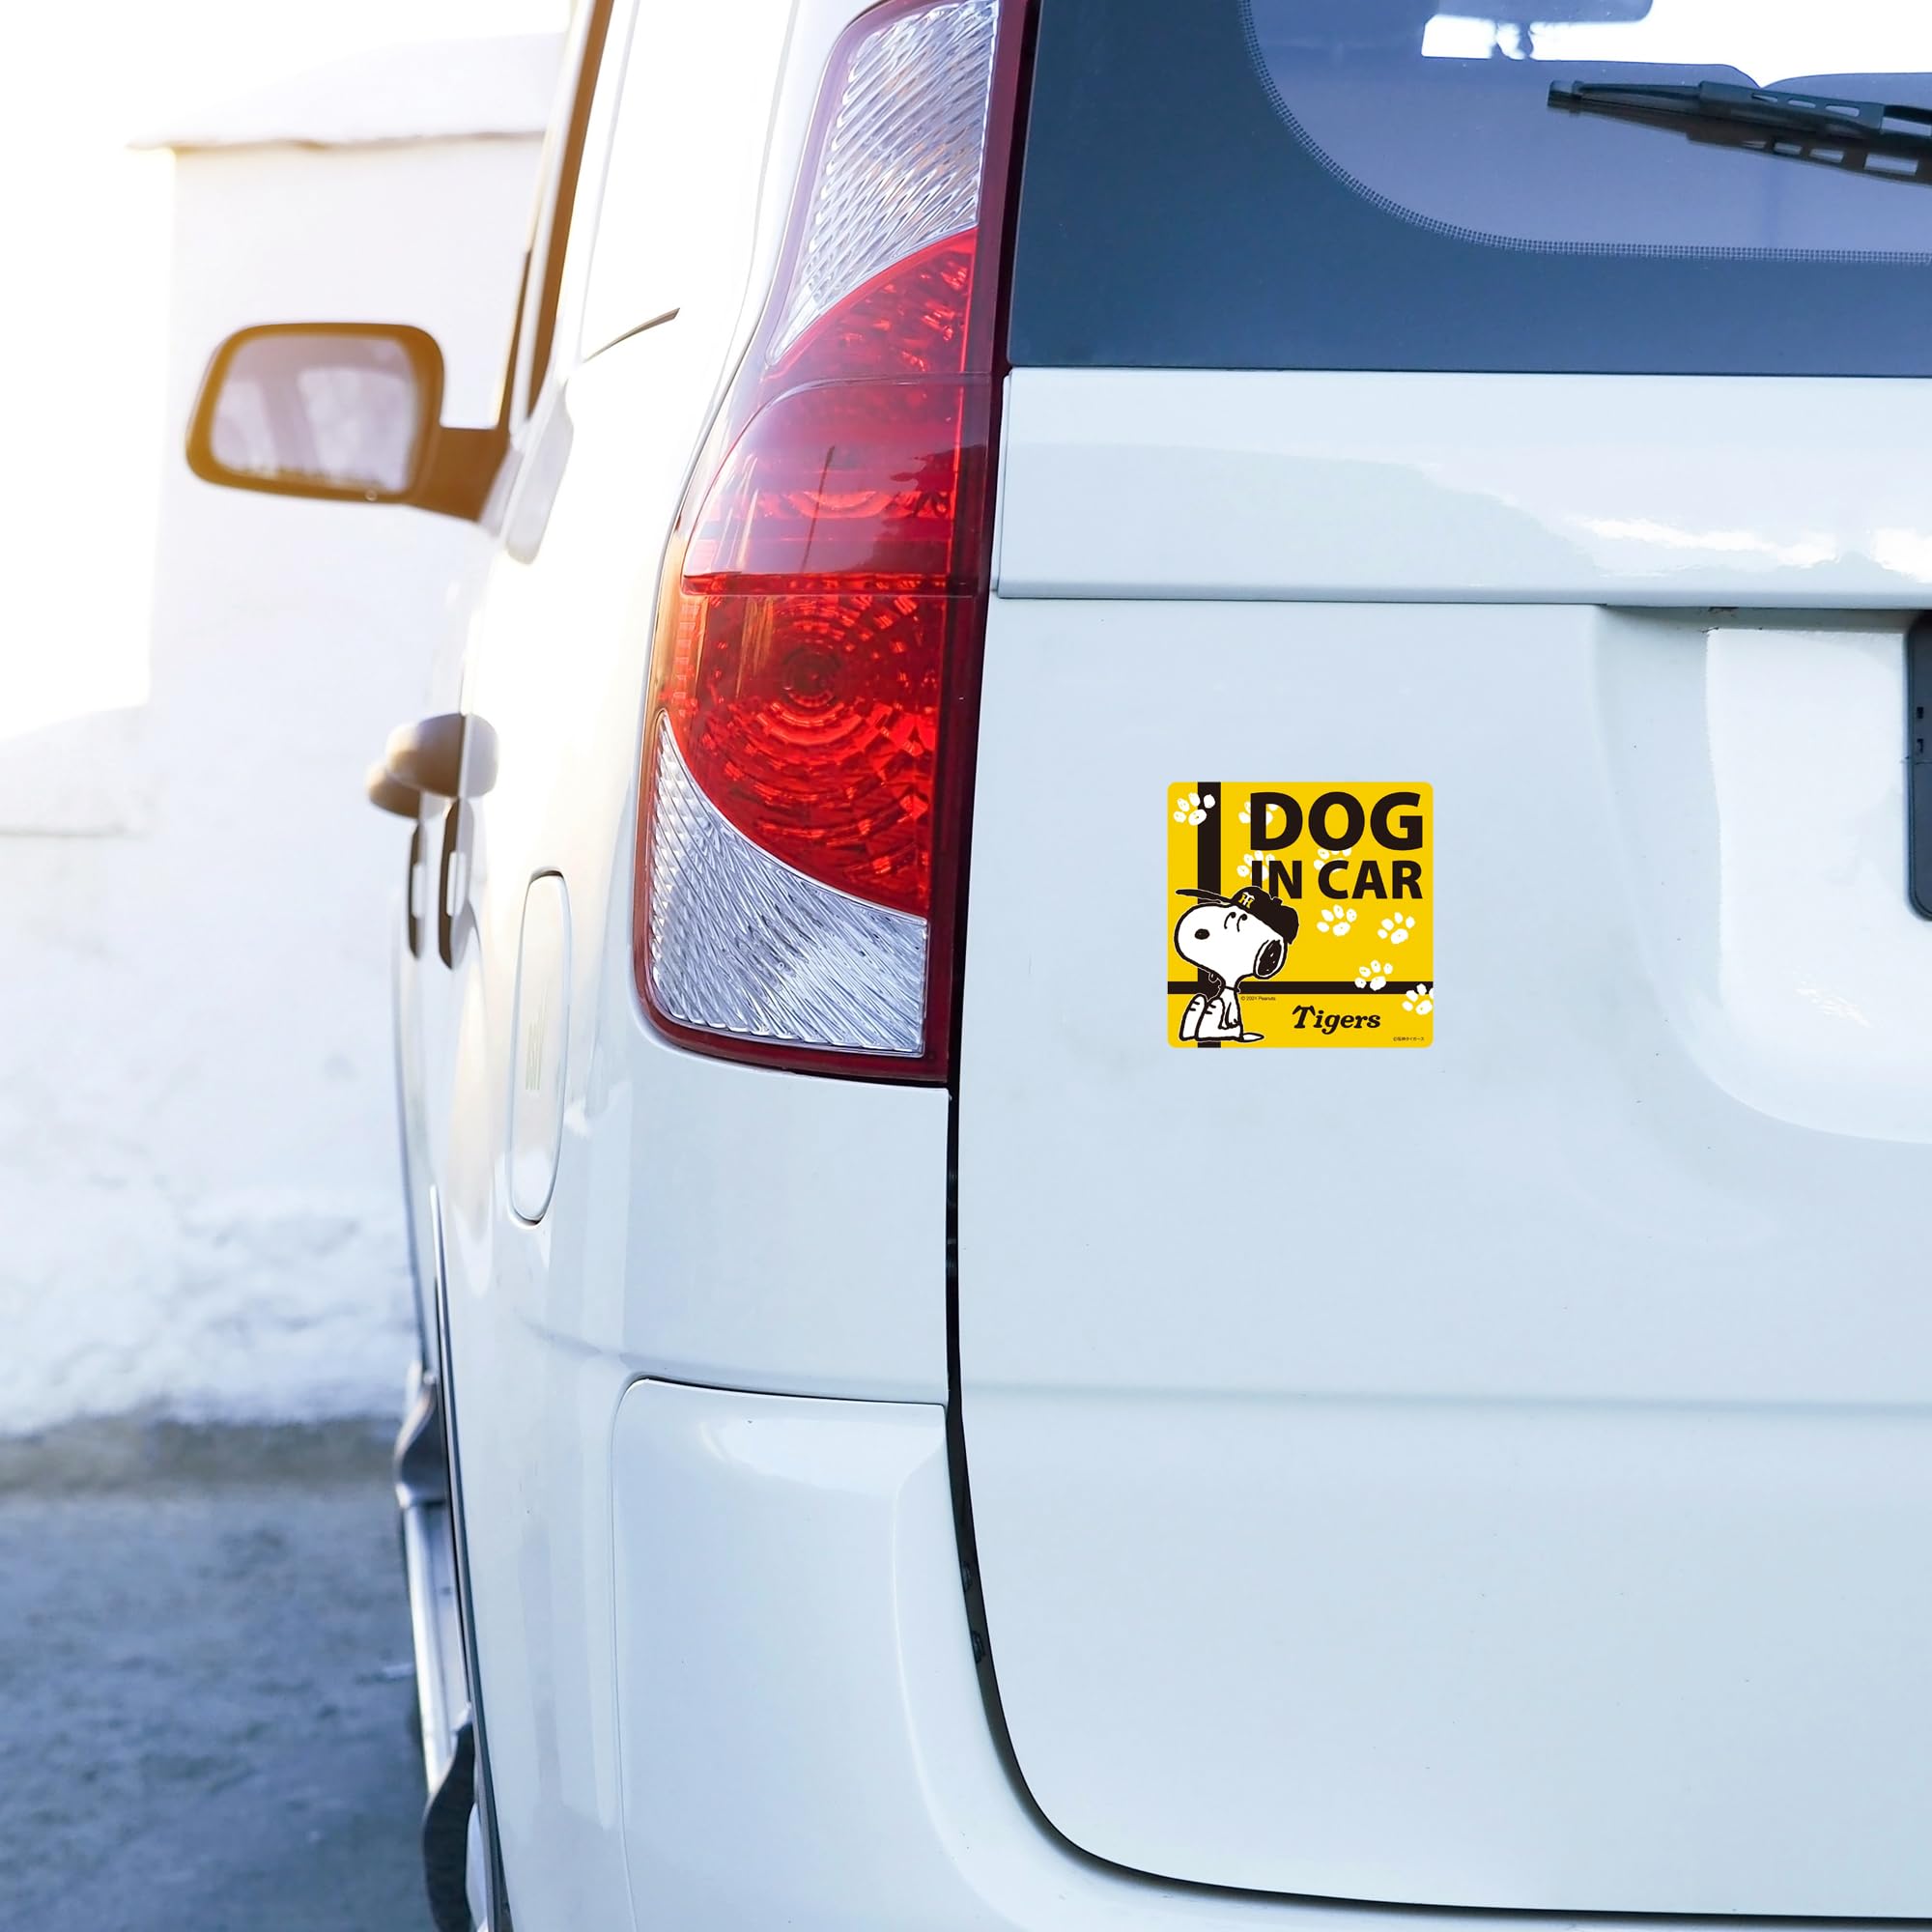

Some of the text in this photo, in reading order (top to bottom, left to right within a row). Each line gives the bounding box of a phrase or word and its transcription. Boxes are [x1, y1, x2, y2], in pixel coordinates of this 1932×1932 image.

[1250, 791, 1423, 851] DOG
[1251, 860, 1423, 899] IN CAR
[1292, 1005, 1380, 1035] Tigers
